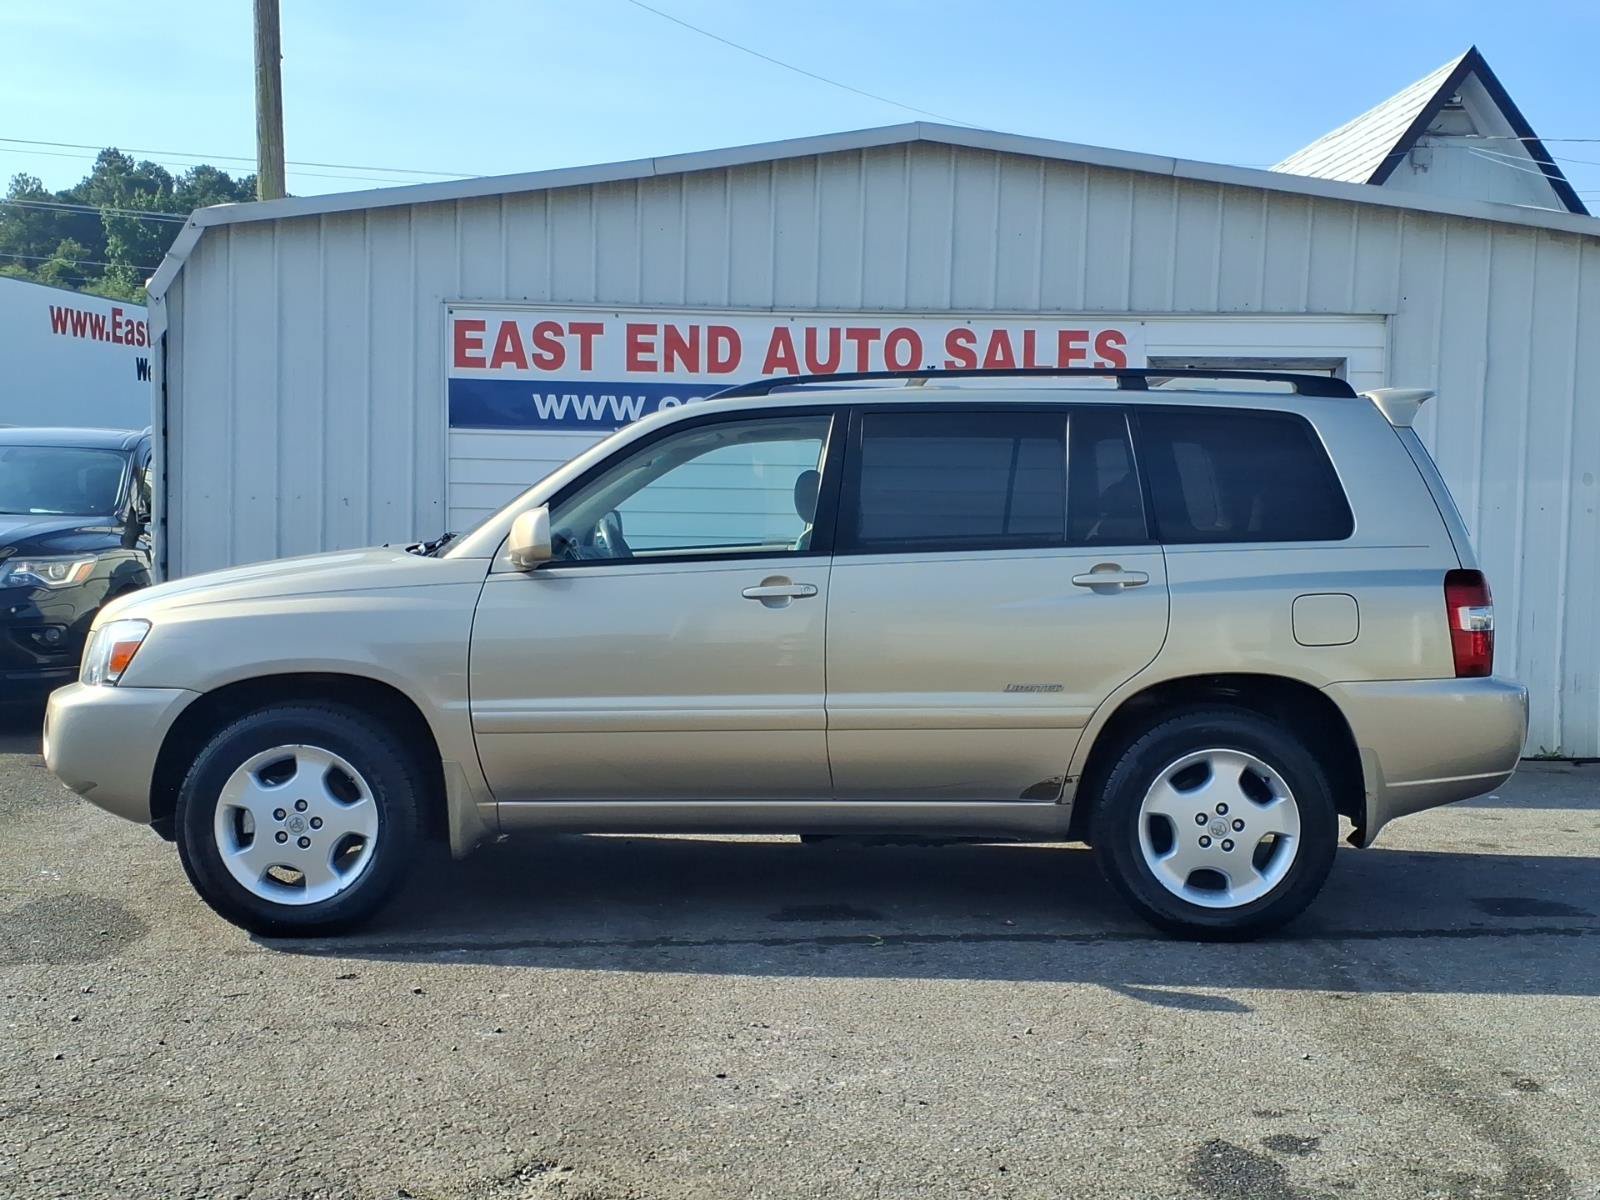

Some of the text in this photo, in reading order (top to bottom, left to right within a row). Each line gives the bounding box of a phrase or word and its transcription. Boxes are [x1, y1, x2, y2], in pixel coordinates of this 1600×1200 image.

[454, 319, 1127, 375] EAST END AUTO SALES
